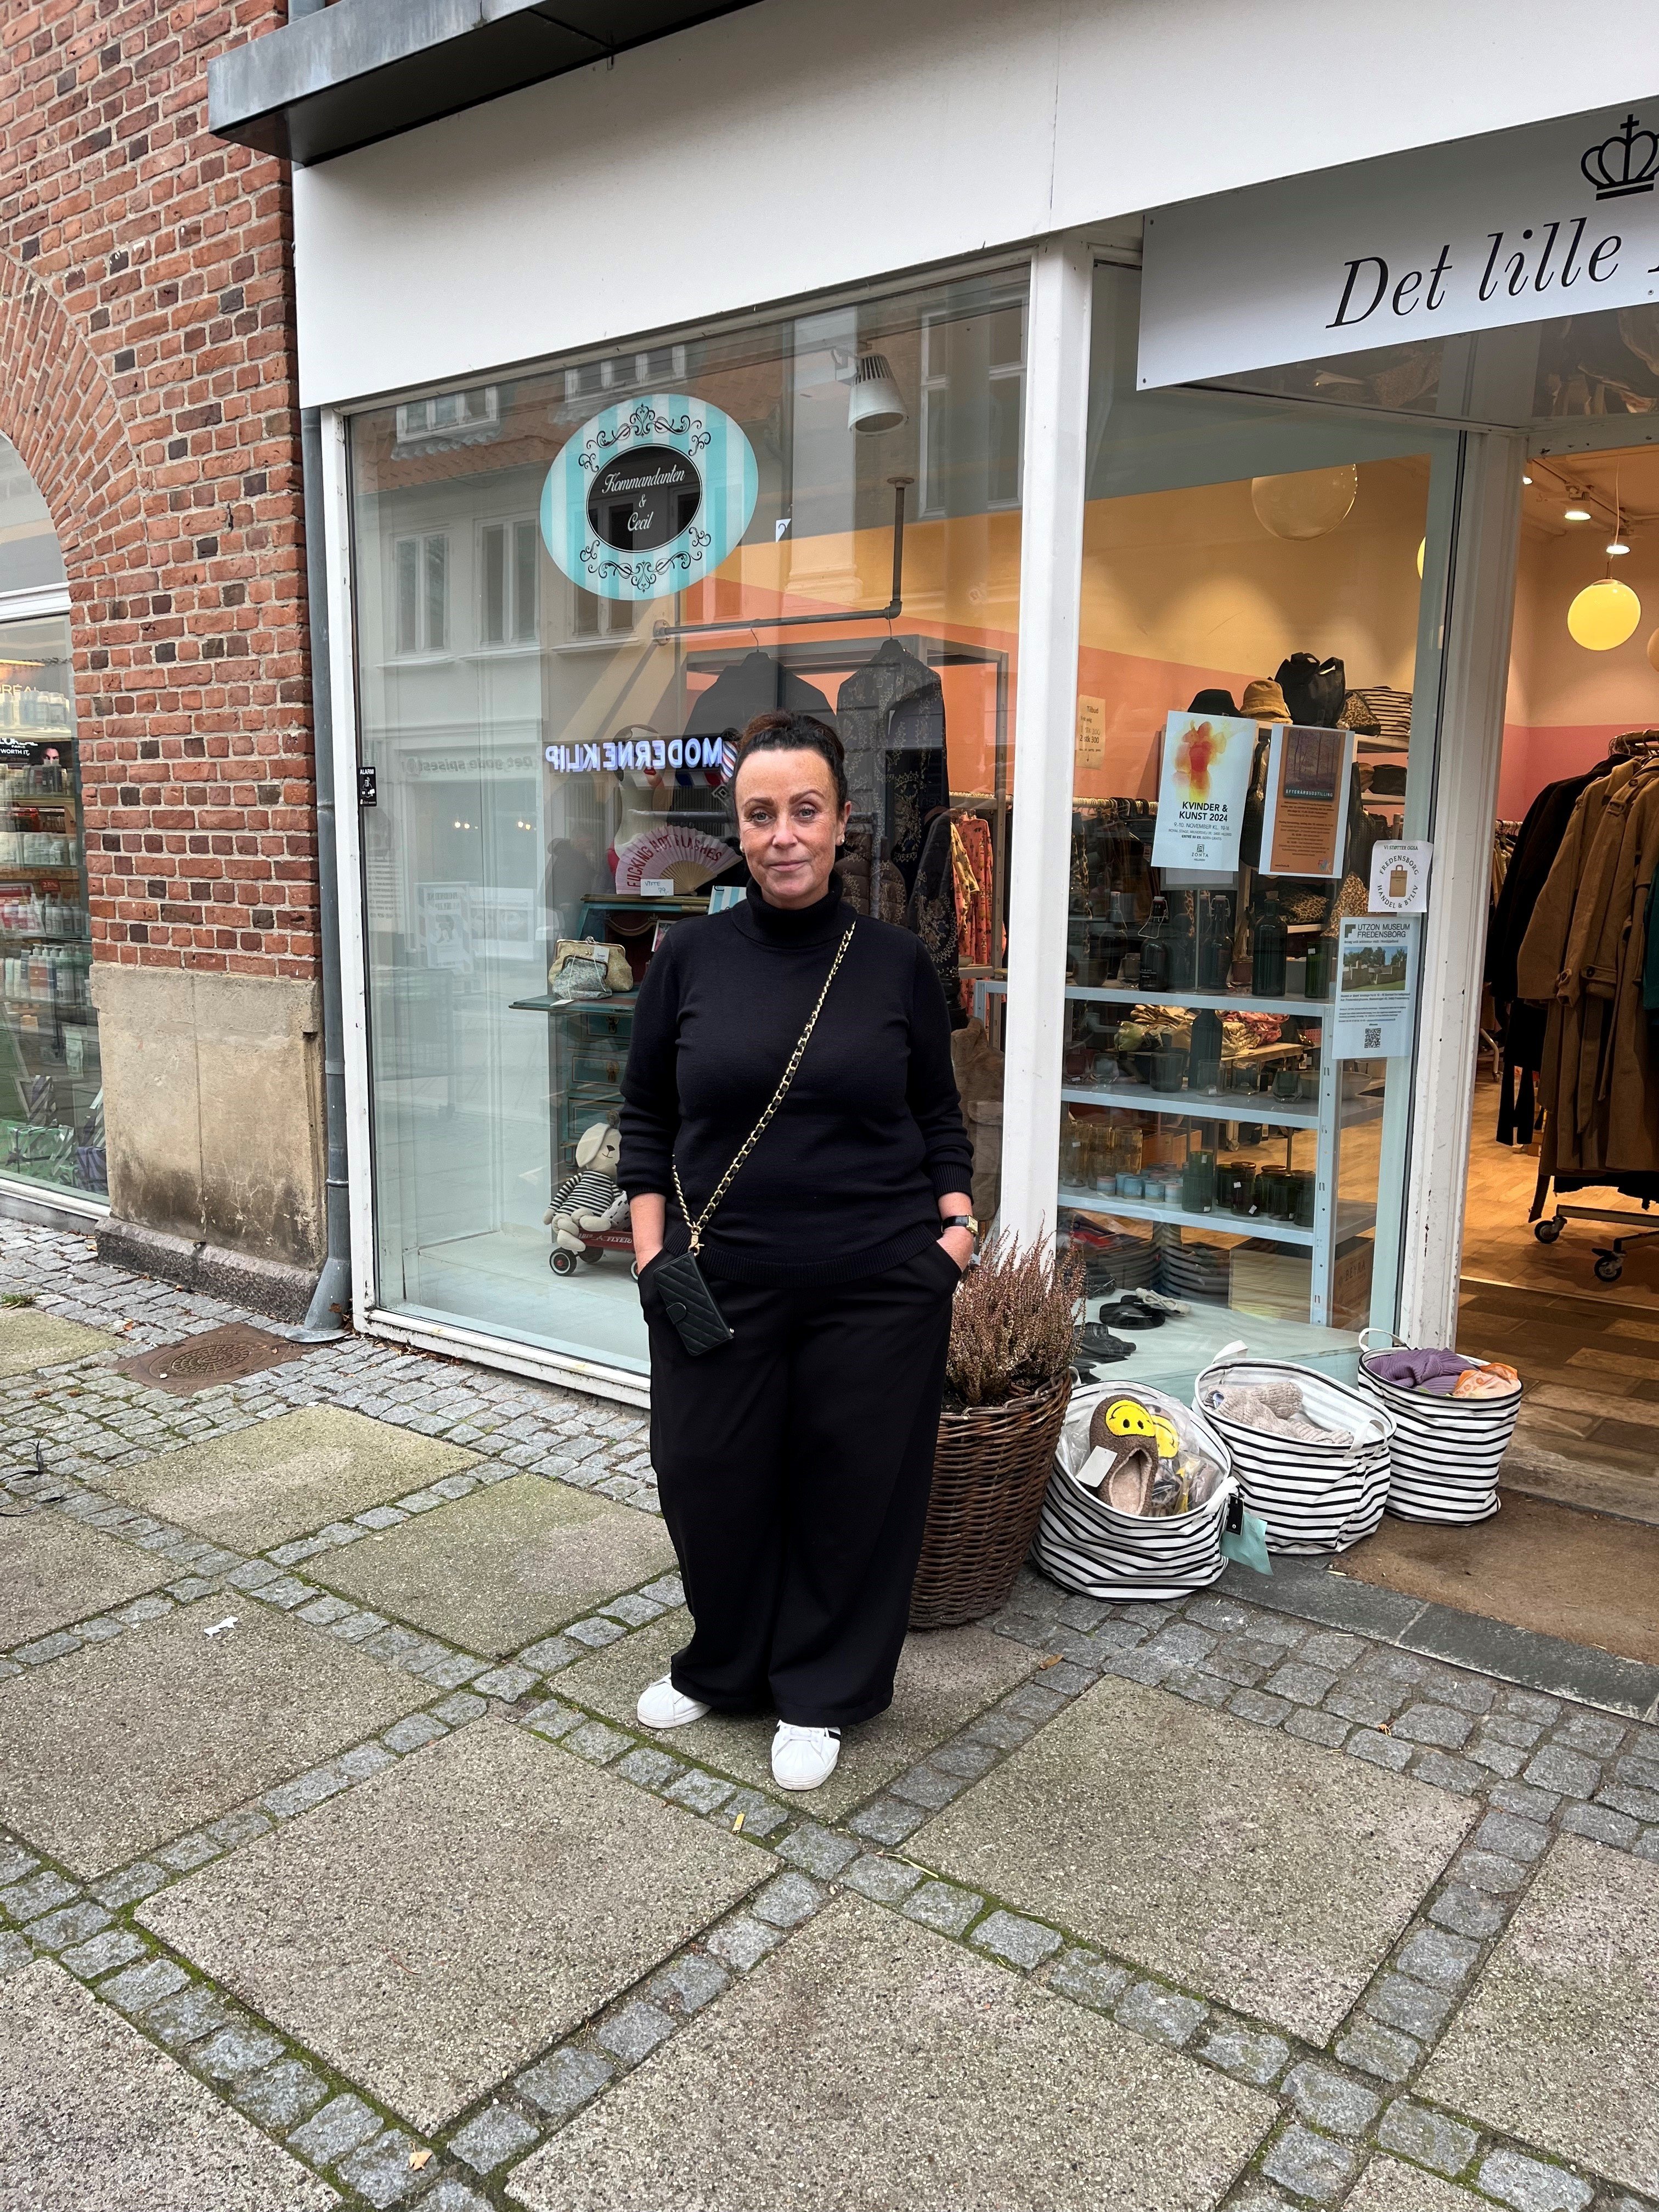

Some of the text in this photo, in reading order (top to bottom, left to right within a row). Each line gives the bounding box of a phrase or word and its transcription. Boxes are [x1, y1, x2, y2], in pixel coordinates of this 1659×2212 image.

[1325, 217, 1623, 329] Det lille
[602, 464, 686, 494] Kommandanten
[639, 494, 647, 508] &
[627, 511, 654, 532] Cecil
[1179, 811, 1228, 822] KUNST 2024
[1182, 801, 1228, 812] KVINDER &
[627, 834, 723, 887] FUCKING HOT FLASHES
[1379, 855, 1419, 875] FREDENSBORG
[1377, 884, 1396, 909] HANDEL
[1404, 885, 1418, 906] BYLIV
